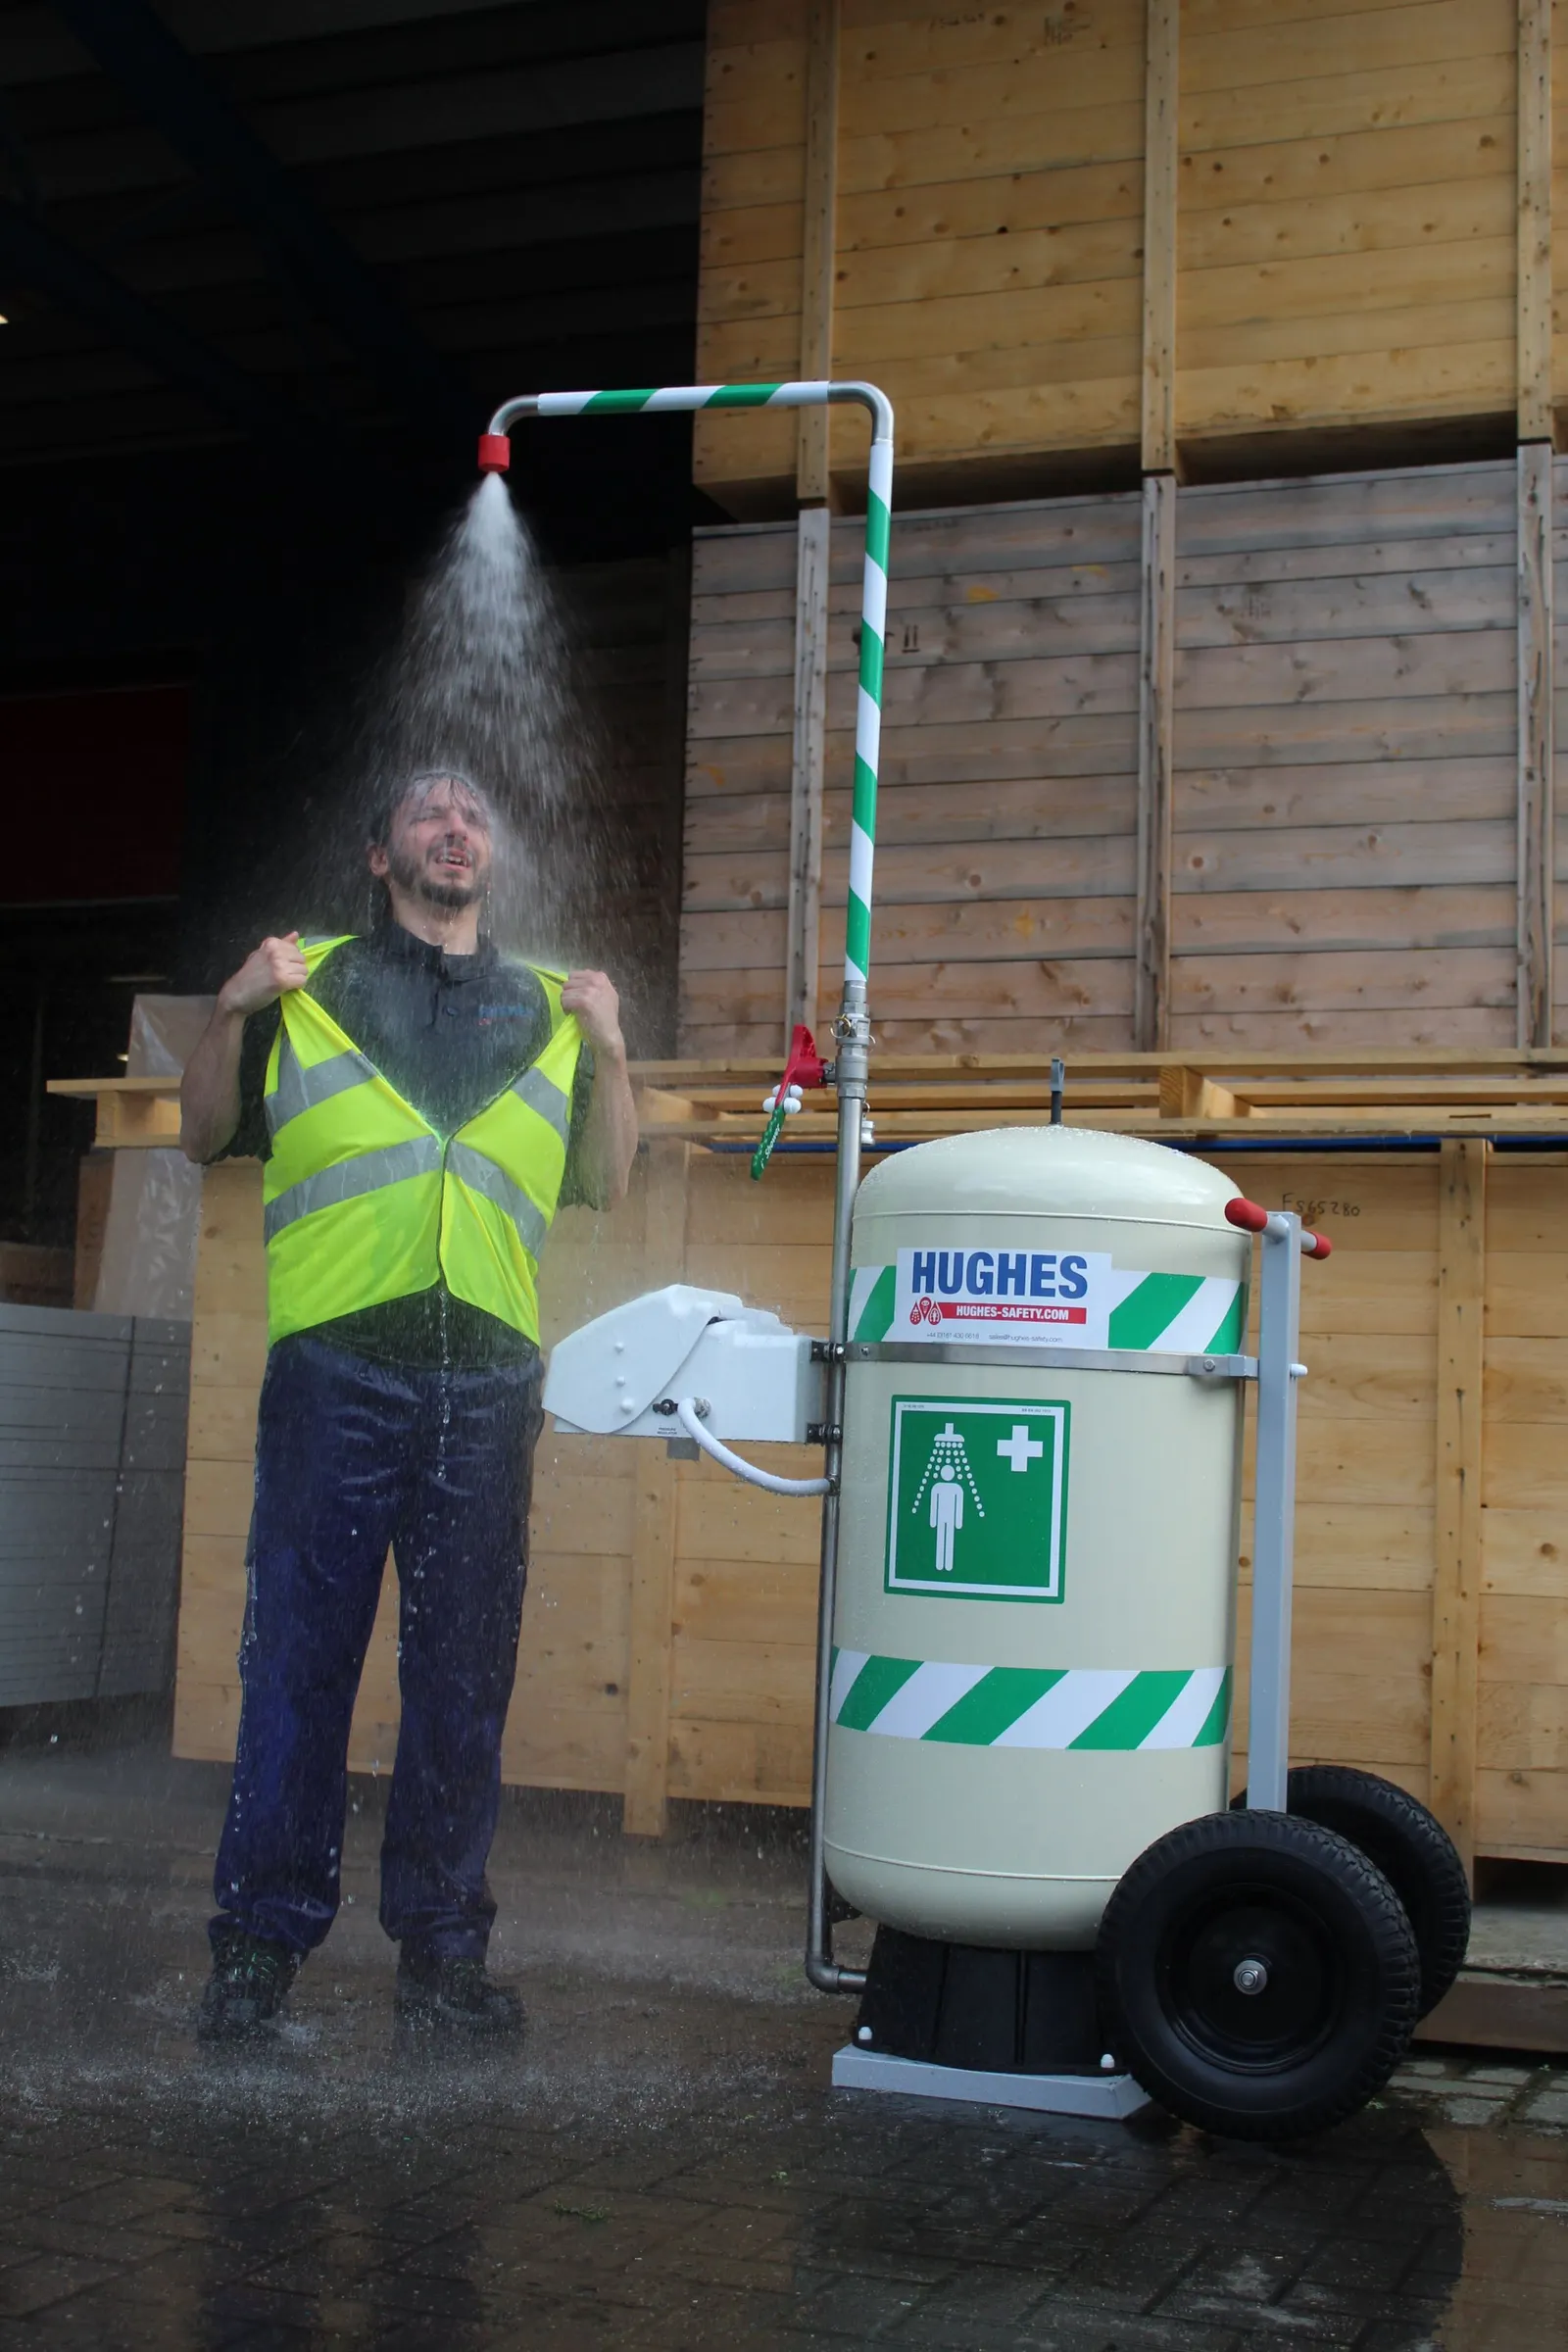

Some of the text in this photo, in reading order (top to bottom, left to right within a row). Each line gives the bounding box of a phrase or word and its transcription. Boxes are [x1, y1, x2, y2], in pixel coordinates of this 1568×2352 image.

[764, 1123, 780, 1159] Shower
[911, 1251, 1088, 1299] HUGHES
[956, 1304, 1069, 1321] HUGHES-SAFETY.COM
